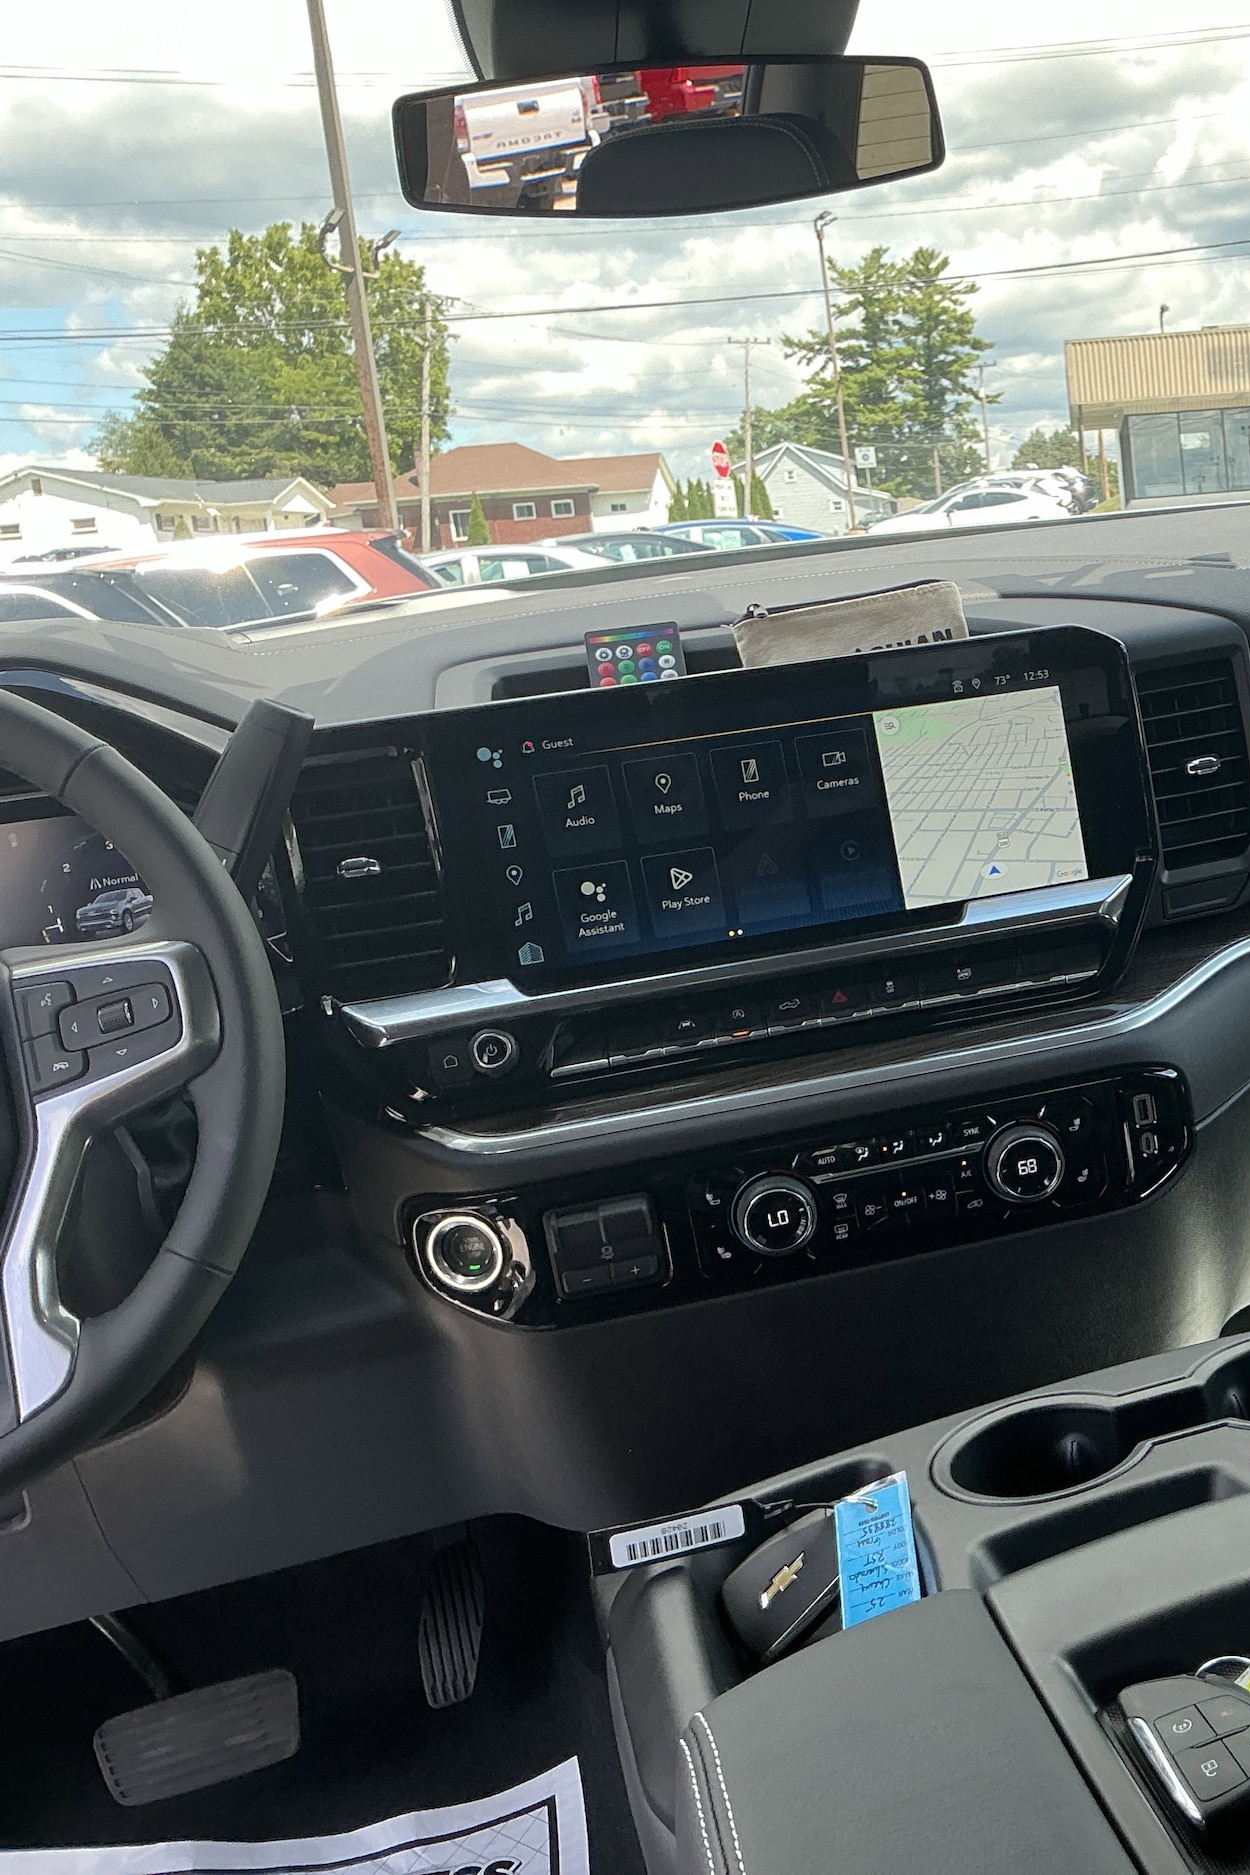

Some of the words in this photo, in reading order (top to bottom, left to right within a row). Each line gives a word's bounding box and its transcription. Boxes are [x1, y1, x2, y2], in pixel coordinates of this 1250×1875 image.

[1023, 669, 1050, 682] 12:53
[542, 737, 574, 750] Guest
[816, 777, 860, 790] Cameras
[738, 789, 770, 802] Phone
[654, 803, 683, 815] Maps
[565, 816, 596, 828] Audio
[104, 840, 114, 850] 3
[62, 863, 71, 873] 2
[1056, 867, 1083, 879] Google
[102, 872, 139, 887] Normal
[47, 905, 53, 914] 1
[661, 899, 683, 911] Play
[684, 895, 711, 906] Store
[580, 910, 618, 924] Google
[578, 922, 625, 938] Assistant
[963, 1126, 980, 1137] SYNC
[817, 1155, 836, 1166] AUTO
[1017, 1158, 1038, 1177] 68
[893, 1195, 918, 1208] ON/OFF
[767, 1209, 790, 1228] LO
